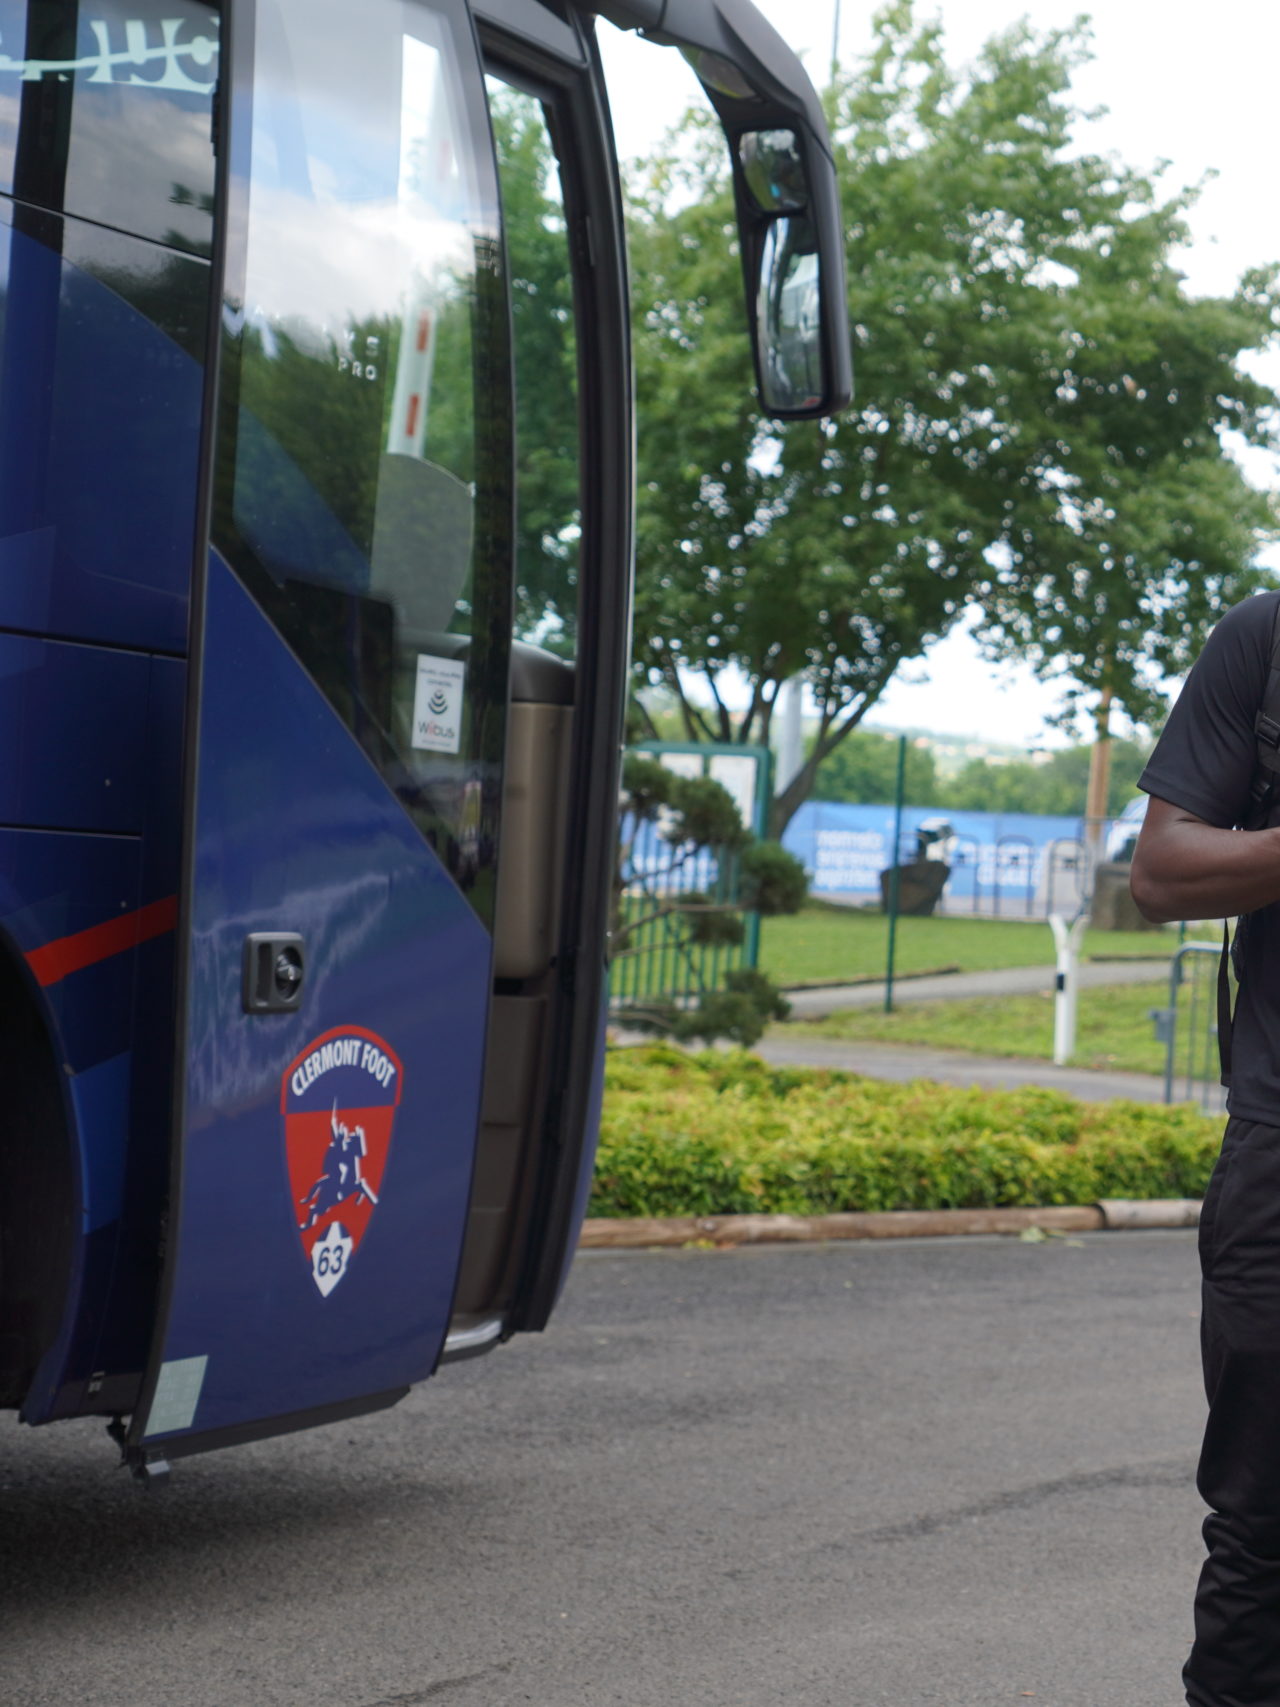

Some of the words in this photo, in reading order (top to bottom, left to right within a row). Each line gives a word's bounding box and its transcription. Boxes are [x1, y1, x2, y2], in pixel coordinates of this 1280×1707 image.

[291, 1039, 363, 1097] CLERMONT
[361, 1042, 396, 1089] FOOT
[318, 1244, 344, 1277] 63
